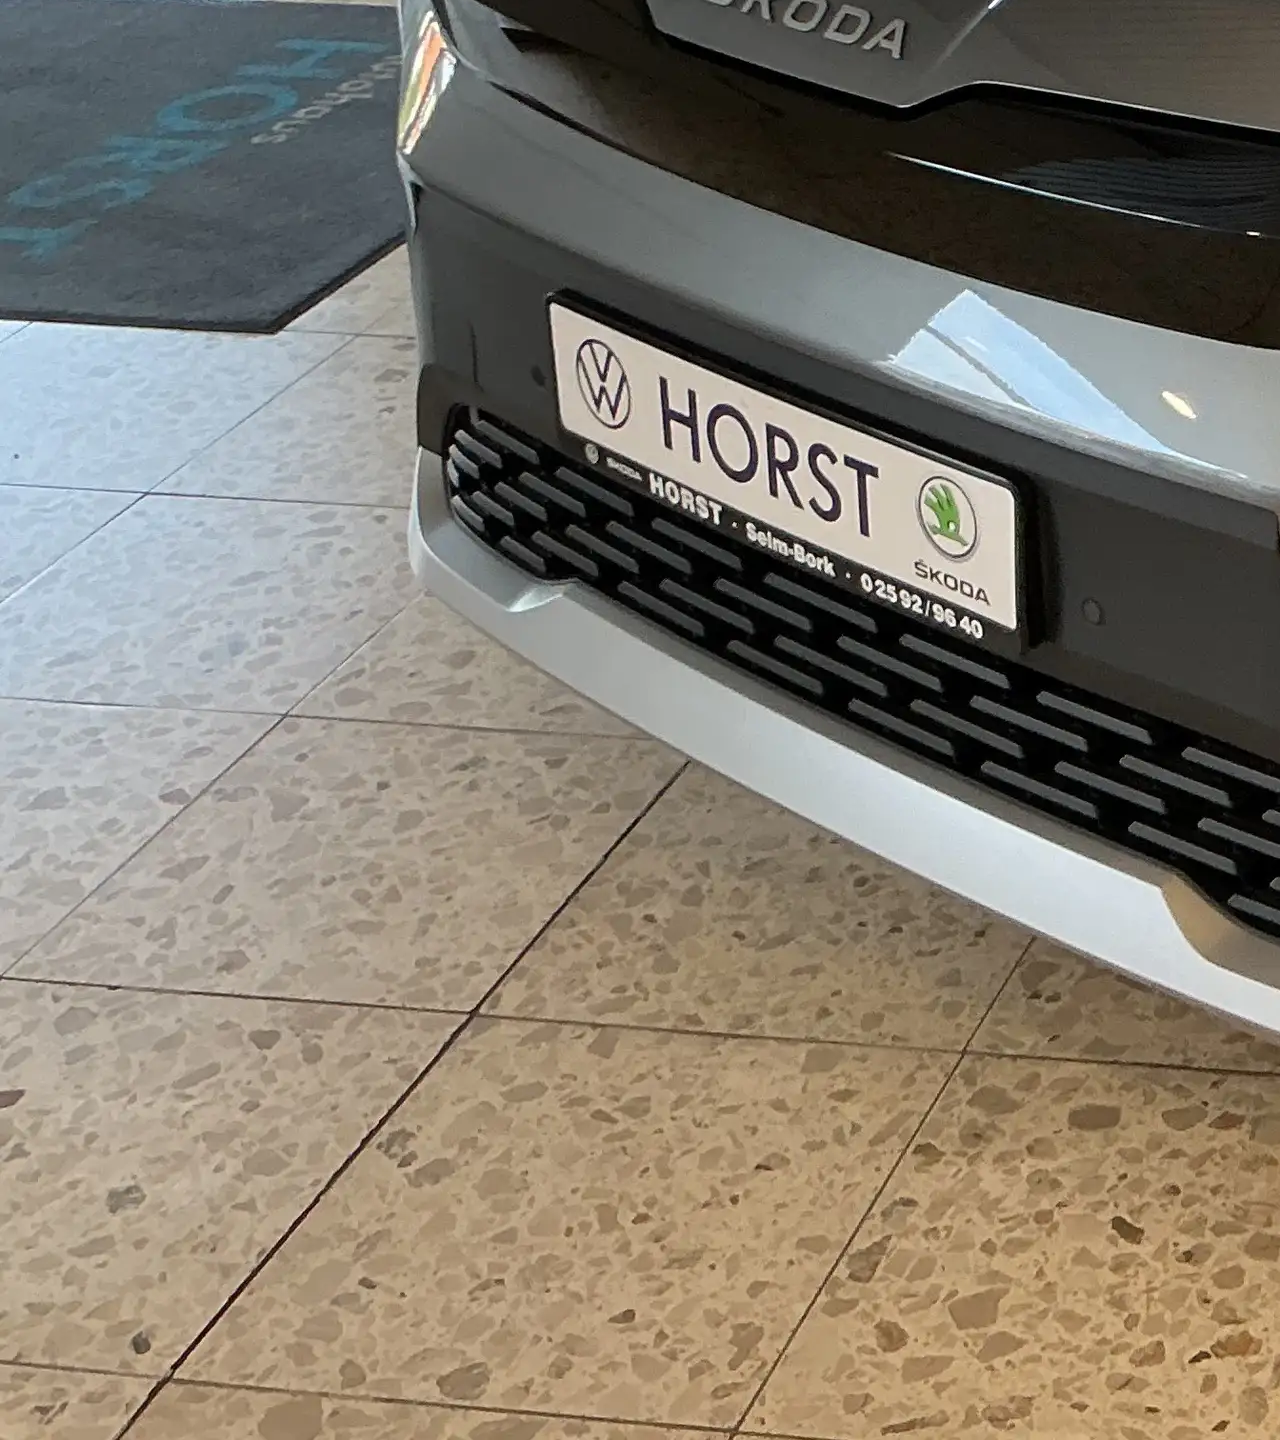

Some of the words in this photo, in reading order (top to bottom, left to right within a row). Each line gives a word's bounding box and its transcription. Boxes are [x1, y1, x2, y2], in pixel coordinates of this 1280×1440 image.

[658, 375, 879, 538] HORST
[650, 471, 723, 526] HORST
[745, 522, 836, 579] Selm-Bork
[912, 560, 991, 606] ŠKODA
